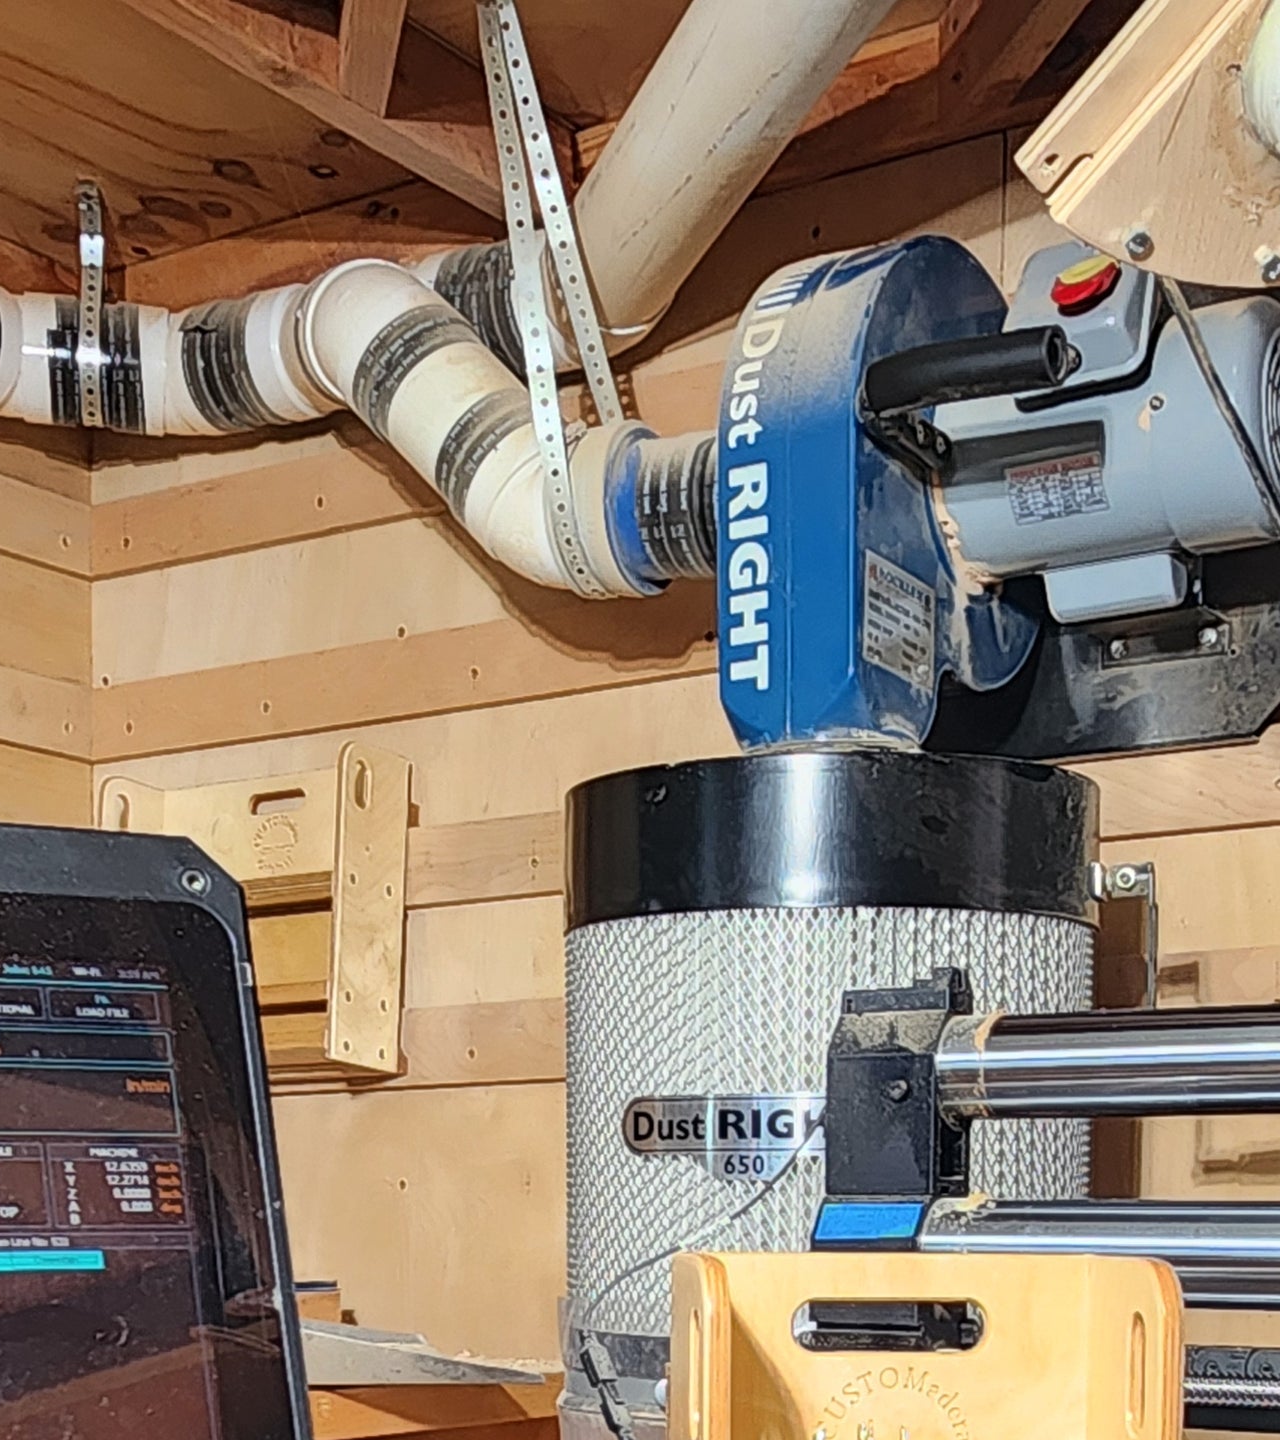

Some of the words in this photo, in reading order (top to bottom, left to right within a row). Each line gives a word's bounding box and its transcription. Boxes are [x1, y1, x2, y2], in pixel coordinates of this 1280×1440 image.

[728, 317, 783, 450] Dust
[728, 462, 771, 691] RIGHT
[632, 1110, 706, 1142] Dust
[723, 1155, 765, 1175] 650
[64, 1174, 77, 1187] Y
[66, 1187, 79, 1200] Z
